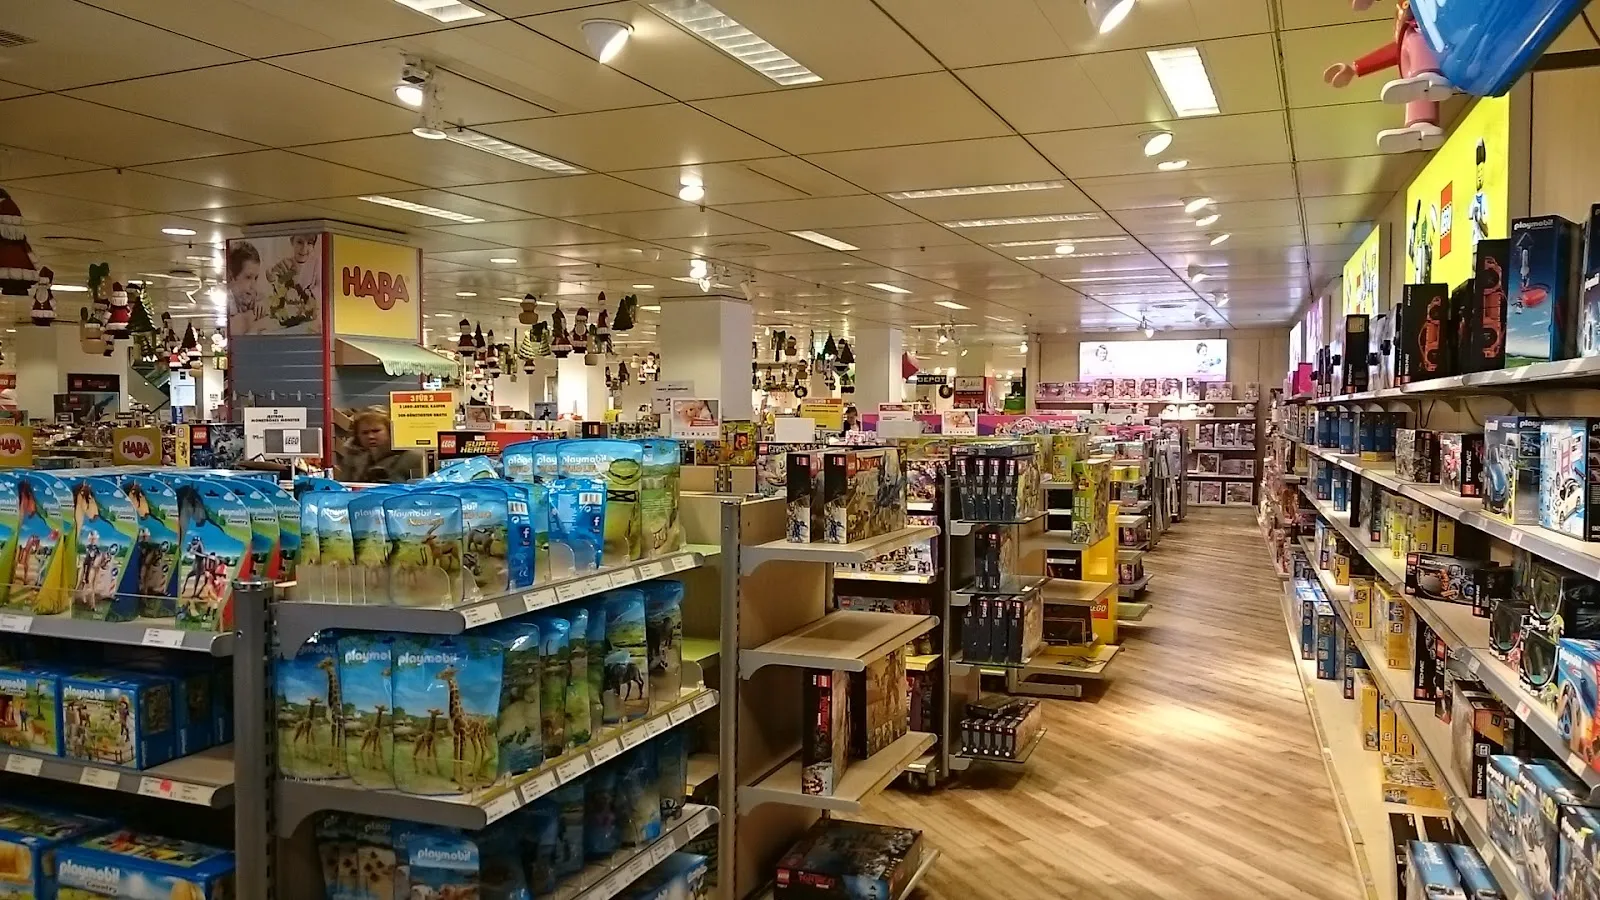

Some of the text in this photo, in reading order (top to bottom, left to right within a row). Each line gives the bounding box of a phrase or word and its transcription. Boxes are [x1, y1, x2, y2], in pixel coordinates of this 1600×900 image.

[1513, 219, 1554, 231] playmobil
[342, 265, 410, 310] HABA
[285, 437, 299, 445] LEGO
[441, 440, 499, 448] LEGO SUPER
[122, 440, 150, 459] HABA
[460, 446, 500, 454] HEROES
[562, 453, 608, 466] playmobil
[397, 651, 458, 667] playmobil
[63, 684, 105, 701] playmobil
[417, 847, 472, 862] playmobil
[59, 859, 120, 884] playmobil
[85, 880, 118, 897] Country
